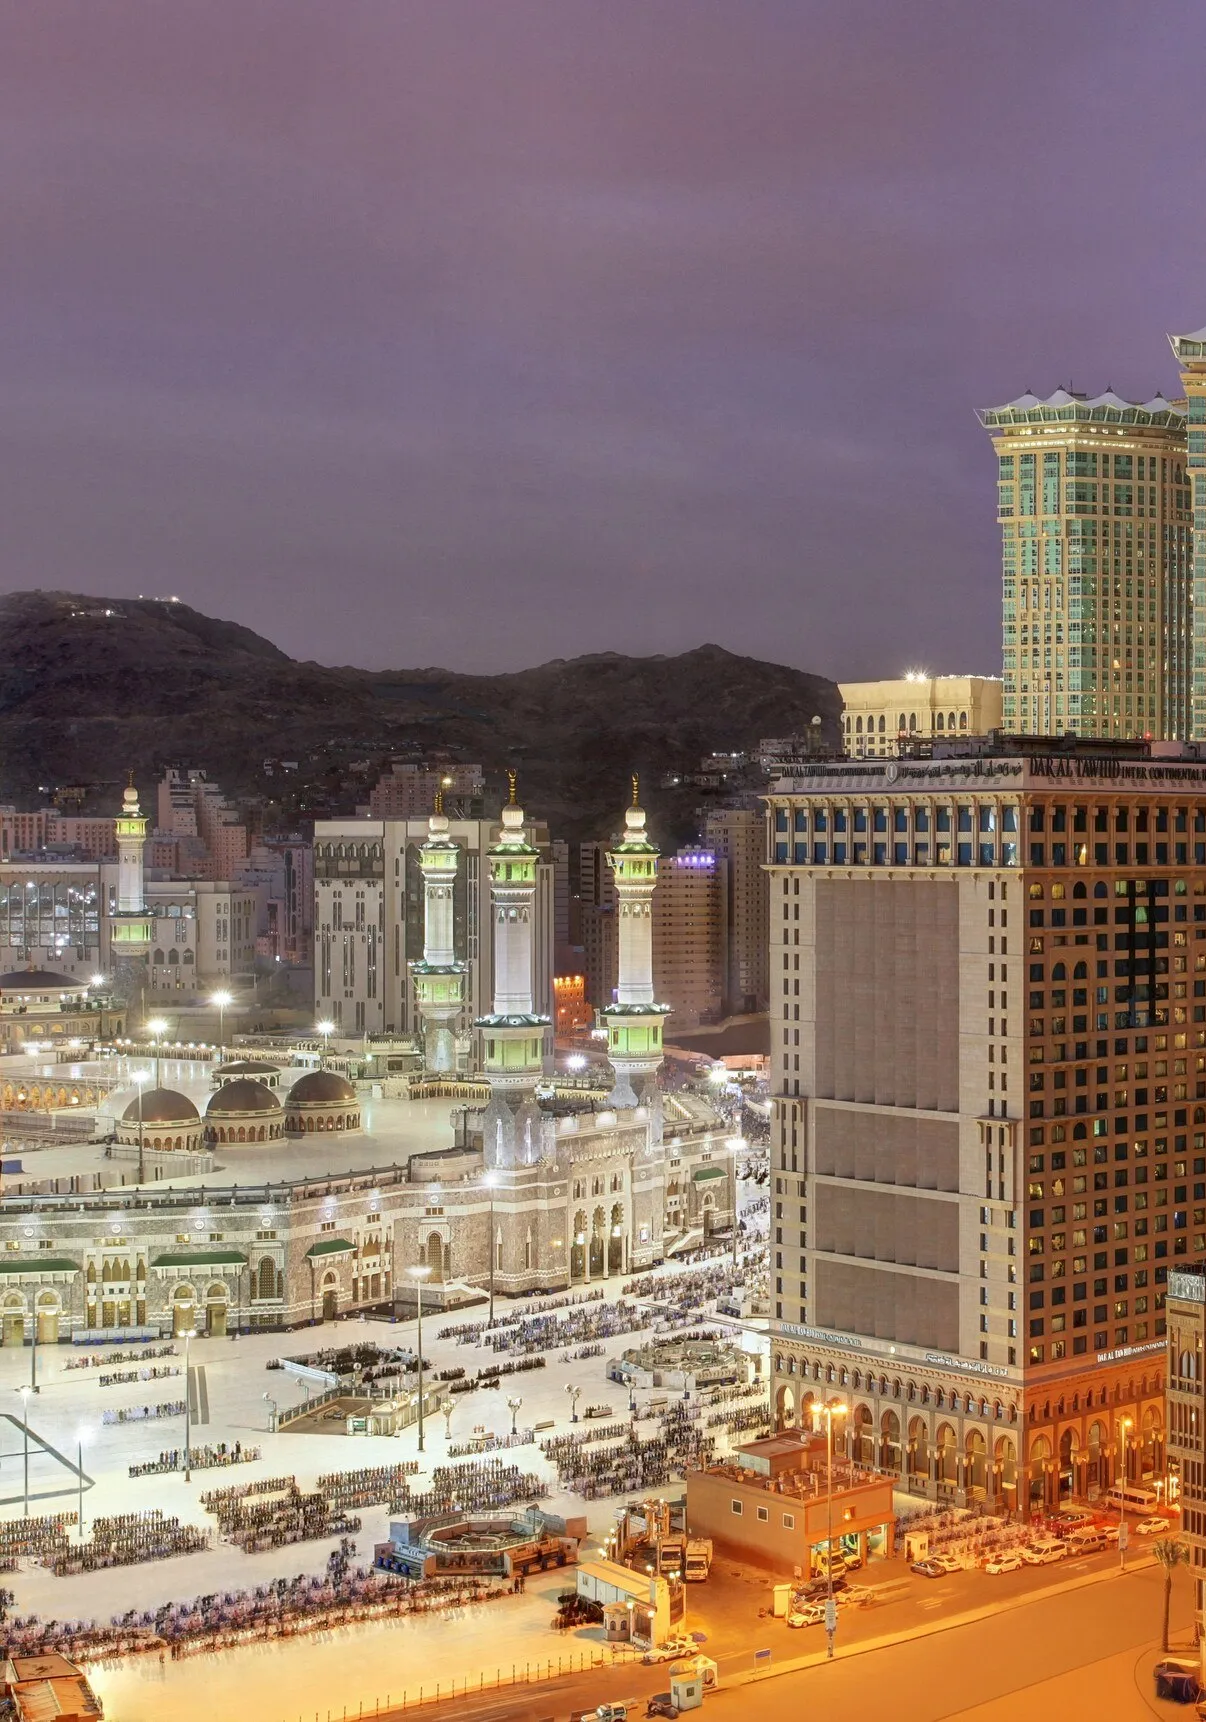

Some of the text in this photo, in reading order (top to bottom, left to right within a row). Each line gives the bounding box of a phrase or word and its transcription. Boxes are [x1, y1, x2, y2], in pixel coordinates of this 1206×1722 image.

[1030, 757, 1056, 777] DAR
[1057, 758, 1073, 777] AL
[1076, 759, 1120, 779] TAWHID
[1122, 766, 1148, 780] INTER
[1148, 767, 1201, 781] CONTINENTAL
